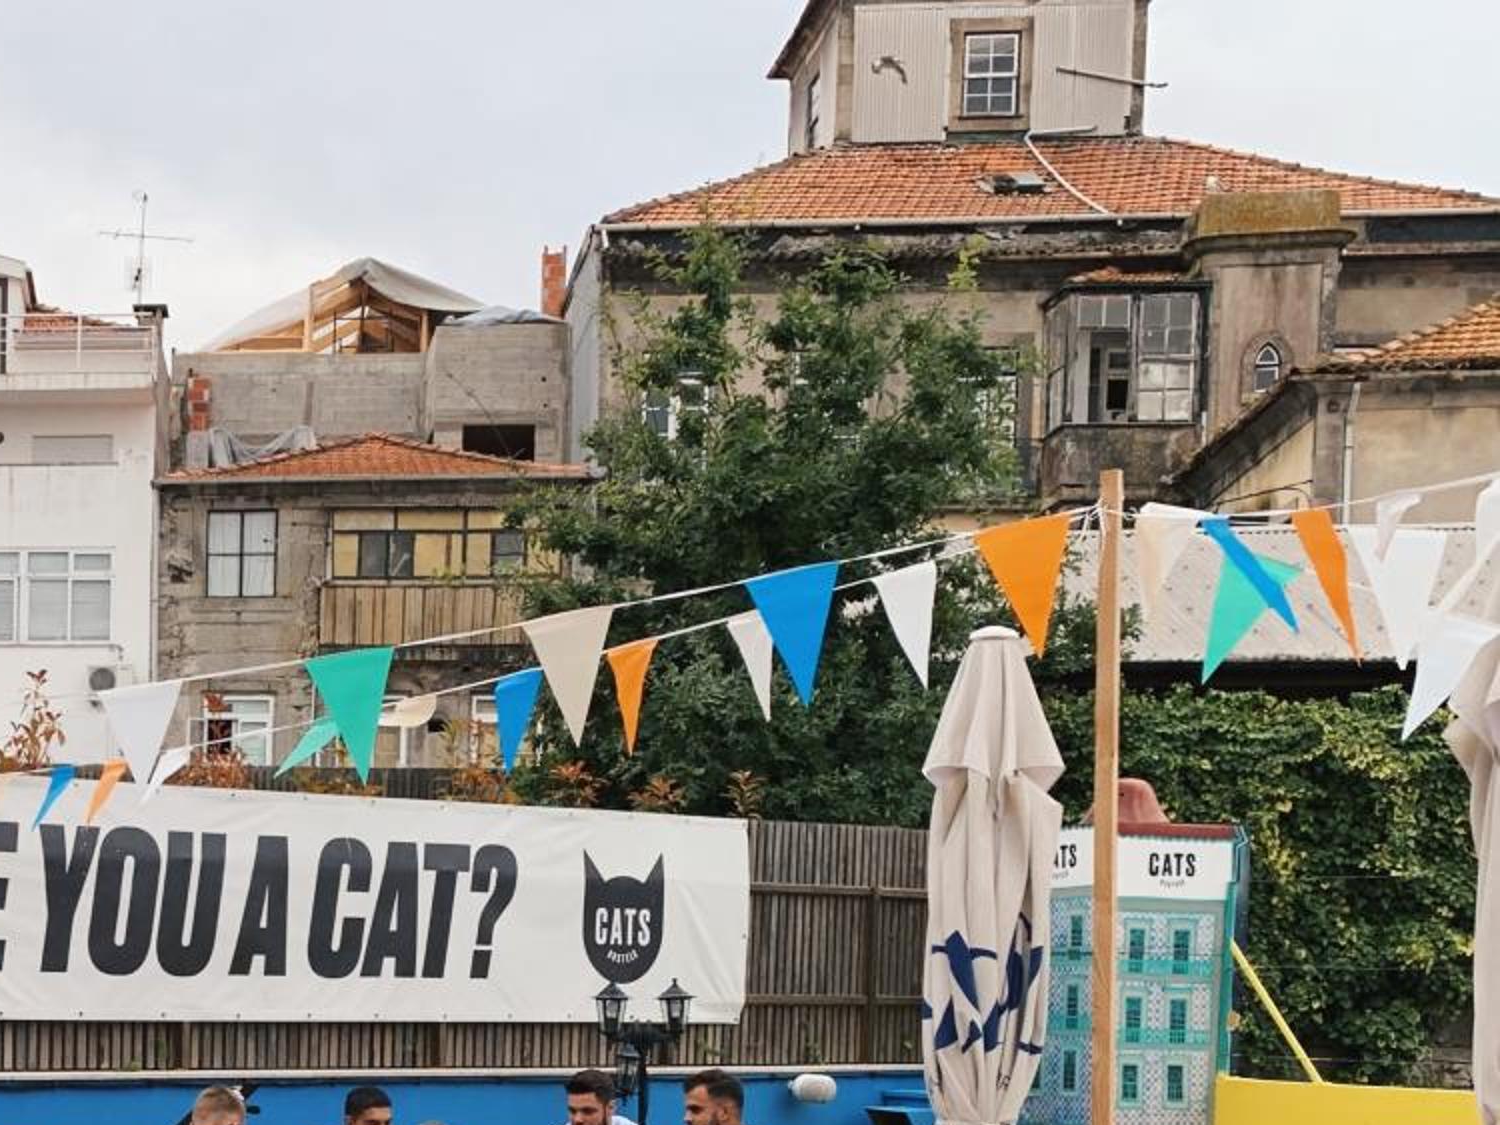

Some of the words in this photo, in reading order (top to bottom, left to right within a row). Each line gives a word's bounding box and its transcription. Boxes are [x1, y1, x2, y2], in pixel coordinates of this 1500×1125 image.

[1148, 852, 1197, 877] CATS
[39, 824, 227, 977] YOU
[228, 835, 289, 976] A
[307, 837, 518, 979] CAT?
[595, 907, 651, 947] CATS
